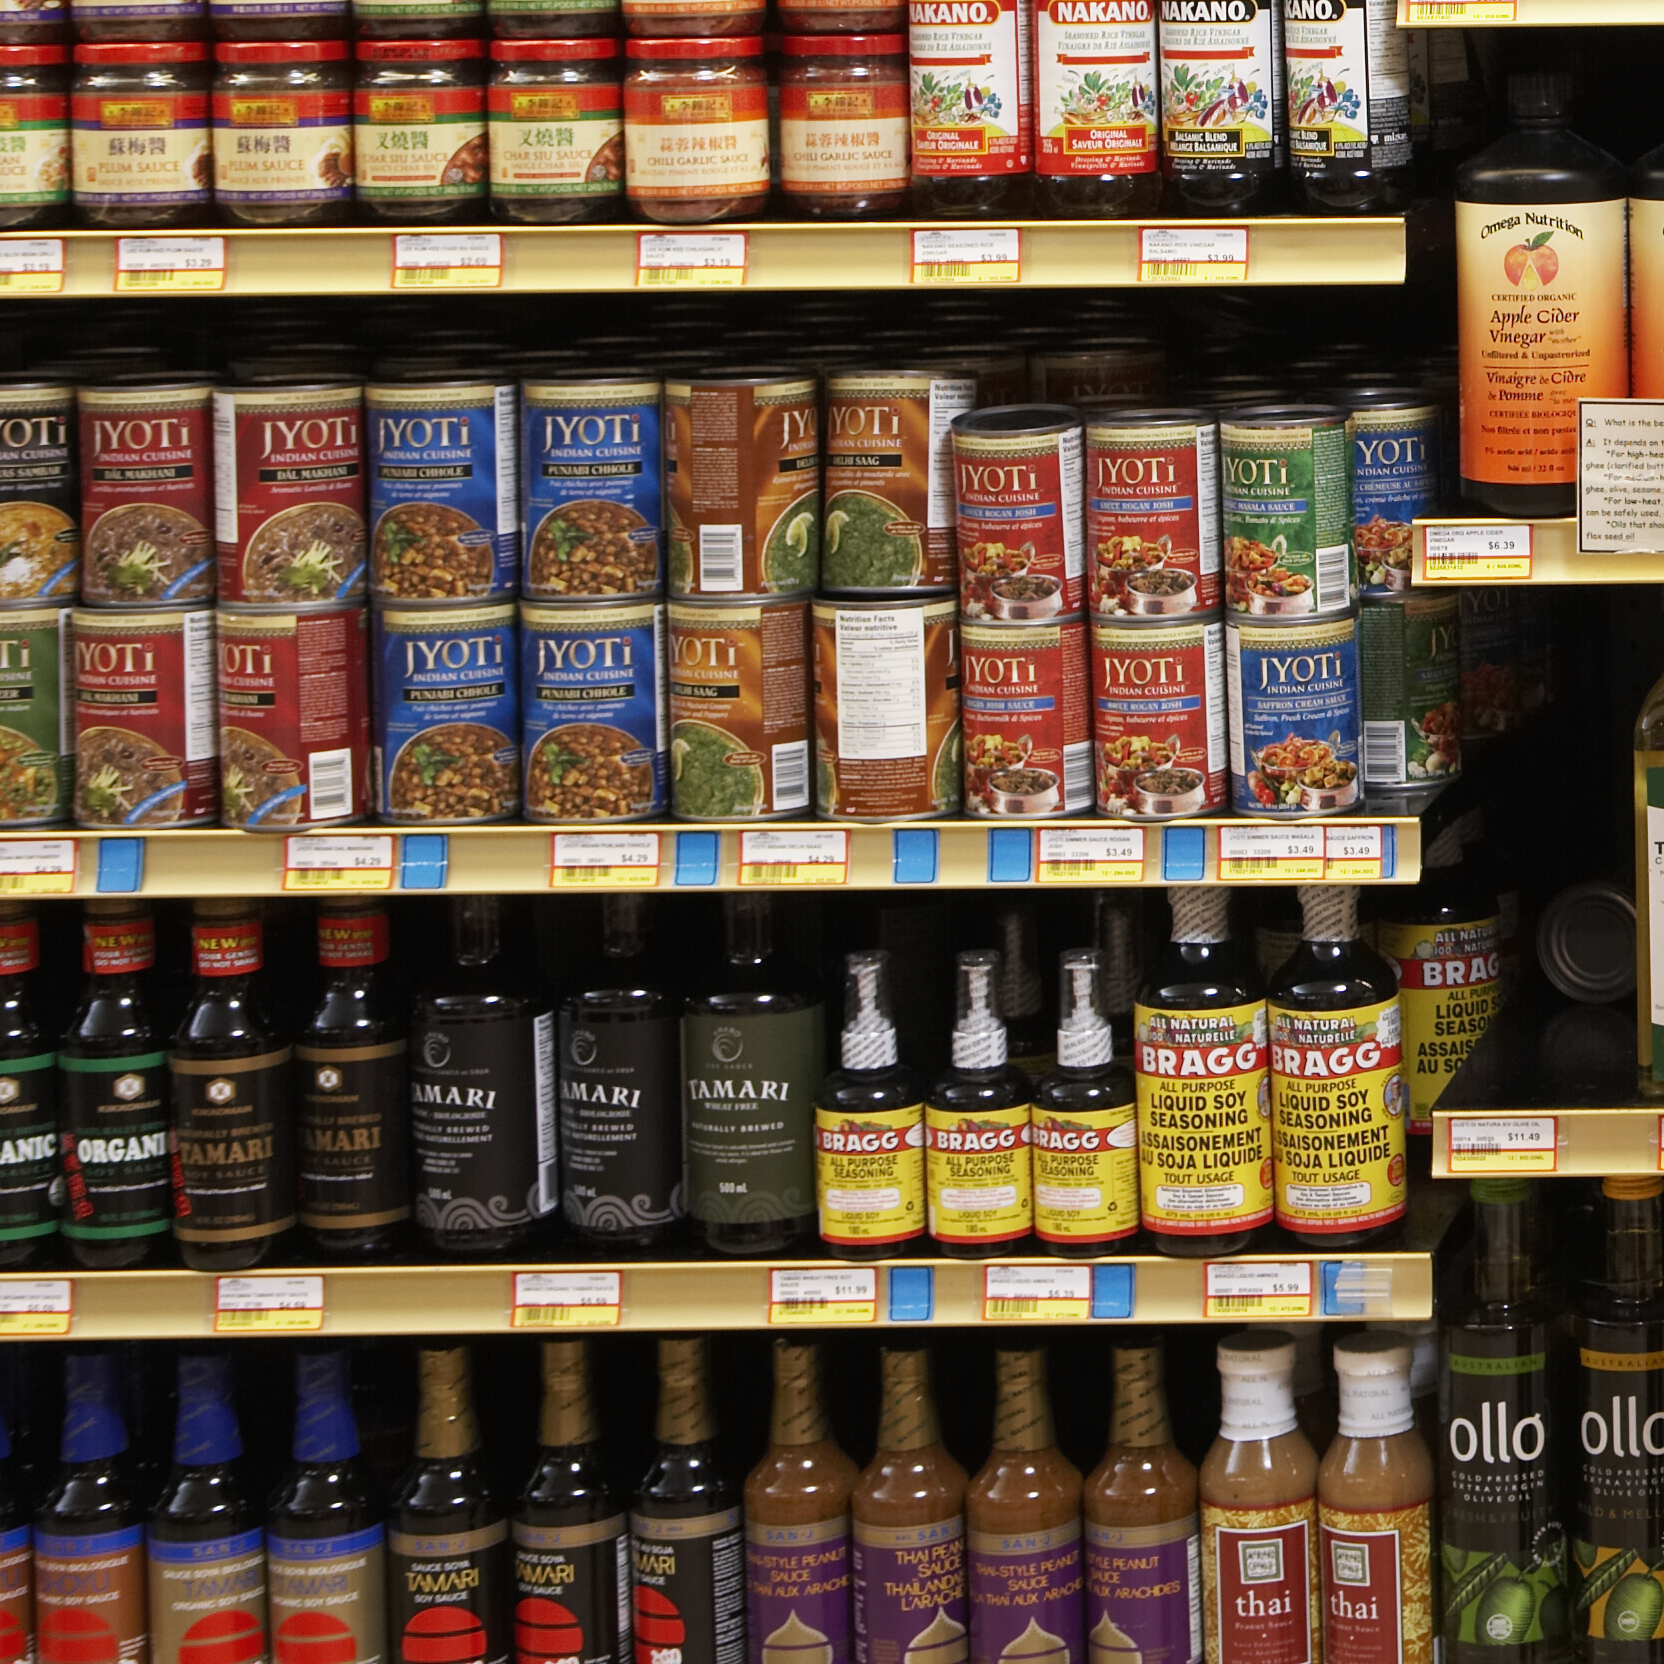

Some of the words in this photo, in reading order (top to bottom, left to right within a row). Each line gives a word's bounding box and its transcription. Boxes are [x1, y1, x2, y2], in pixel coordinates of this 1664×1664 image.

[1090, 128, 1127, 140] ORIGINAL
[184, 258, 212, 268] $3.29
[980, 253, 1008, 263] $3.99
[1604, 419, 1625, 428] What
[1628, 419, 1634, 428] is
[1638, 419, 1651, 428] the
[1488, 541, 1515, 550] $6.39
[839, 615, 874, 624] Nutrition
[876, 614, 896, 623] Facts
[413, 670, 452, 682] INDIAN
[457, 669, 505, 681] CUISINE
[411, 689, 452, 701] PUNJABI
[456, 687, 497, 700] CHHOLE
[1105, 847, 1134, 858] $3.49
[354, 855, 381, 866] $4.29
[1141, 1046, 1258, 1074] BRAGG
[1151, 1094, 1206, 1111] LIQUID
[1210, 1091, 1247, 1110] SOY
[1149, 1109, 1248, 1129] SEASONING
[178, 1136, 273, 1164] TAMARI
[834, 1285, 868, 1295] $11.99
[1273, 1282, 1300, 1293] $5.99
[405, 1569, 480, 1592] TAMARI
[1235, 1592, 1293, 1618] thai
